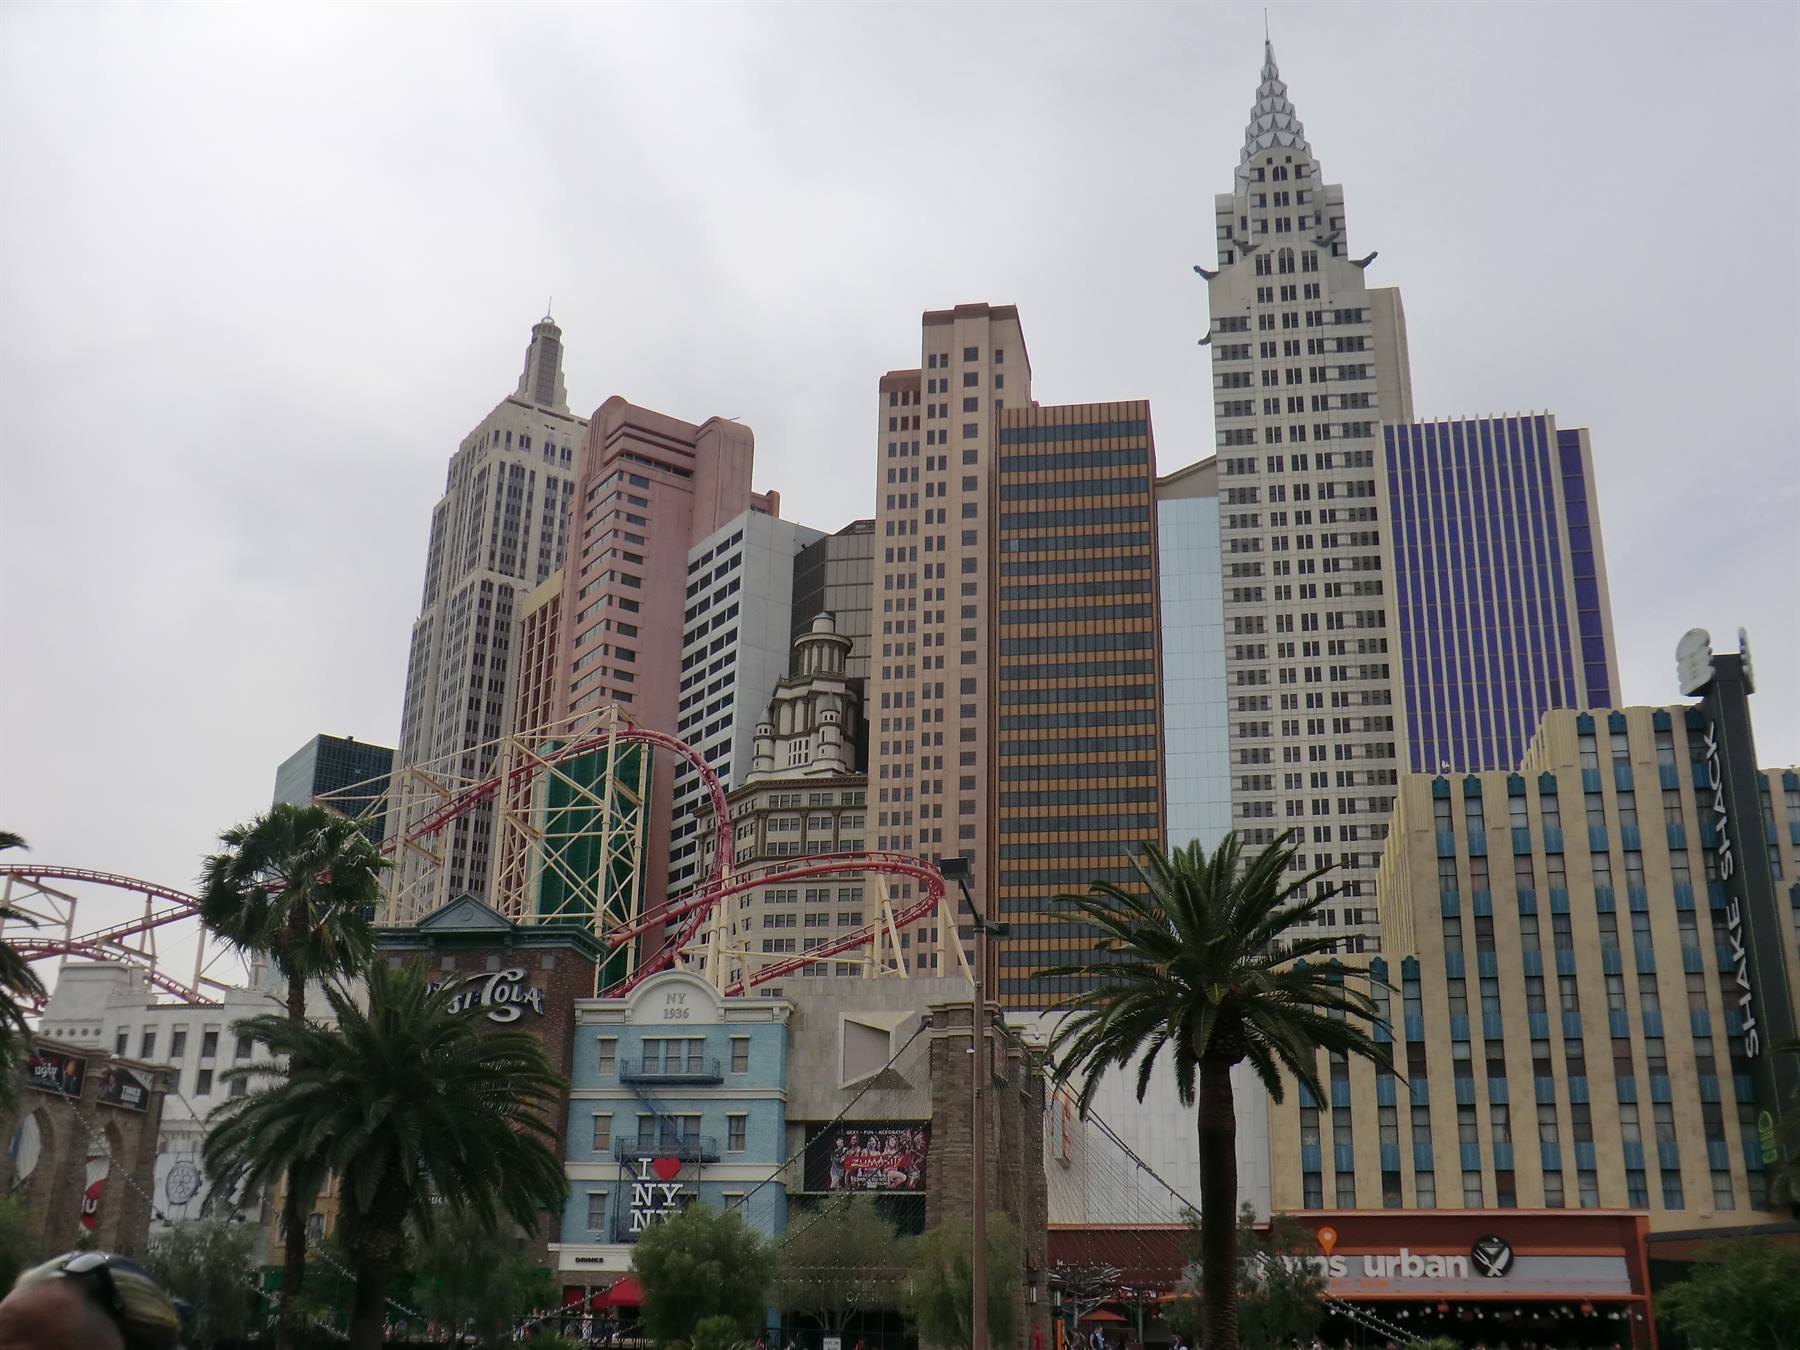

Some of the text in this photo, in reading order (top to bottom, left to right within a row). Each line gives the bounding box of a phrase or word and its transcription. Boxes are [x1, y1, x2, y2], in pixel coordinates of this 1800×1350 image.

[1704, 721, 1759, 1058] SHAKE SHACK
[665, 992, 687, 1005] NY
[663, 1007, 690, 1020] 1936
[637, 1158, 652, 1180] I
[630, 1183, 684, 1207] NY
[1363, 1247, 1469, 1279] urban
